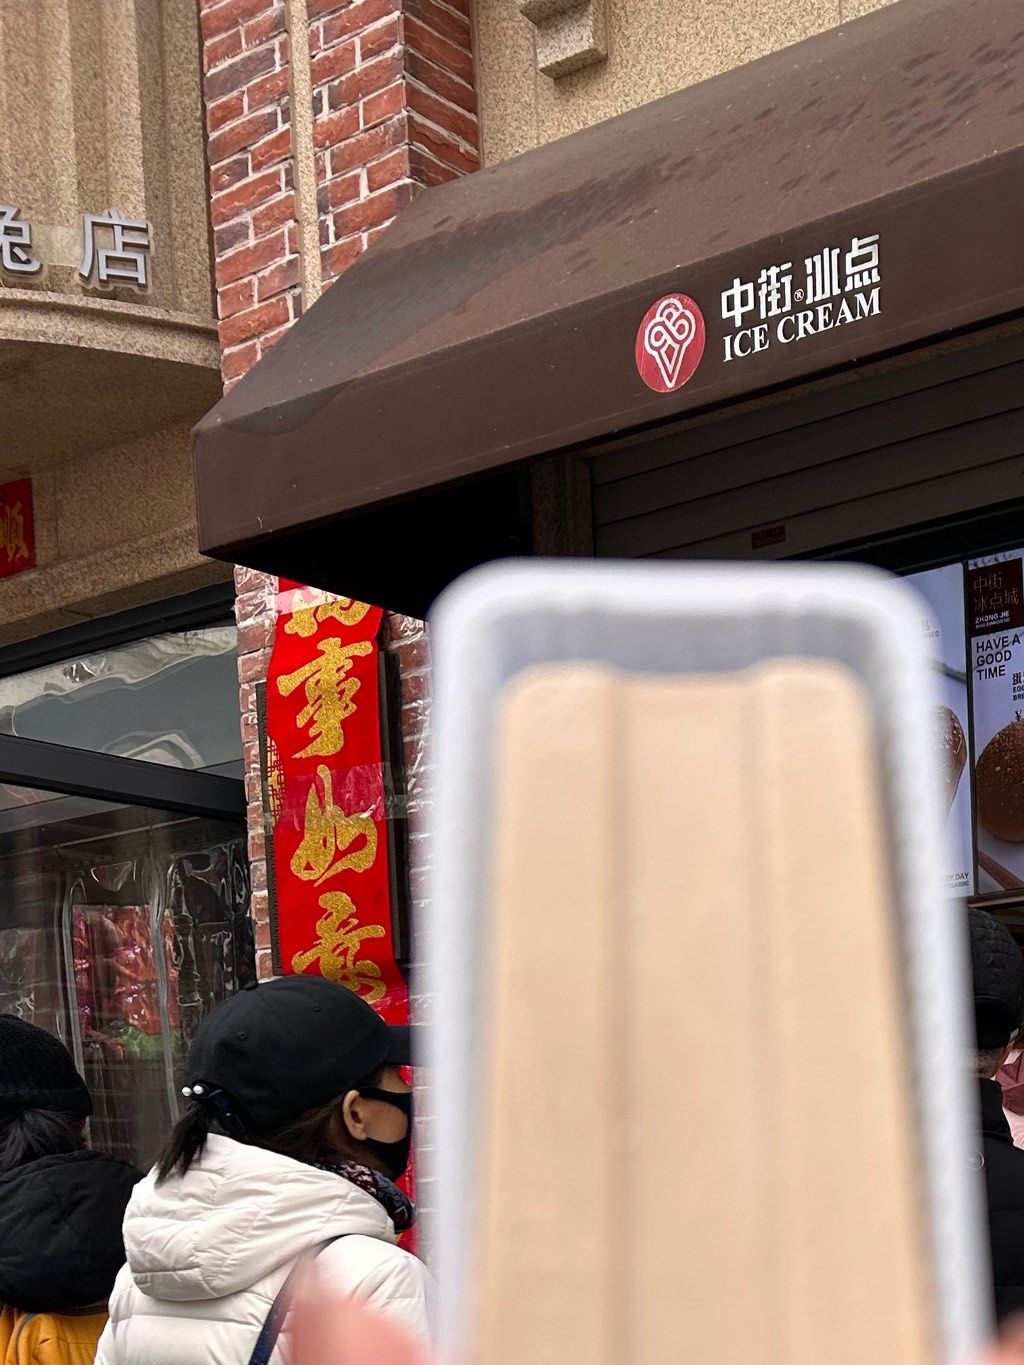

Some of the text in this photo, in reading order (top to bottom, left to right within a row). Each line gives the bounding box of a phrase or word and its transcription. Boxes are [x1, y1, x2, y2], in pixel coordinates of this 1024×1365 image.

[722, 287, 882, 363] ICE CREAM
[973, 572, 1002, 594] 中街
[976, 634, 1021, 653] HAVE A
[976, 650, 1012, 667] GOOD
[976, 665, 1006, 681] TIME
